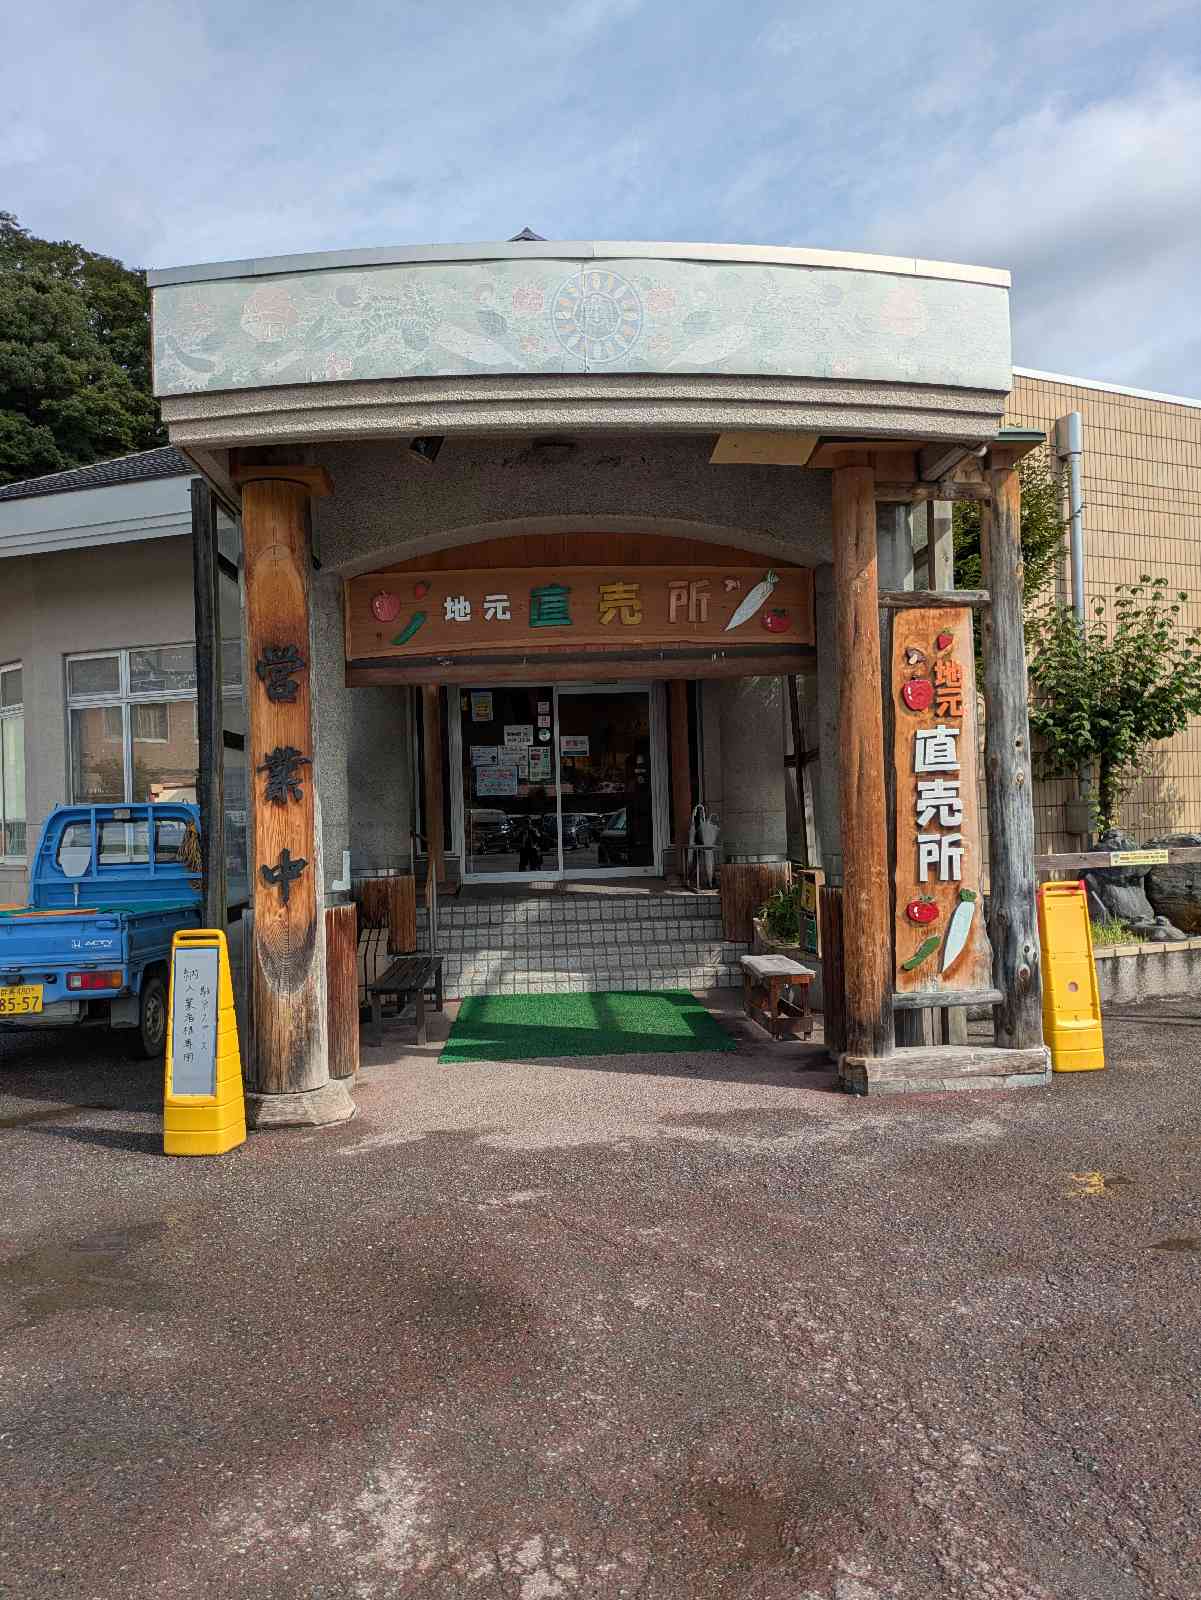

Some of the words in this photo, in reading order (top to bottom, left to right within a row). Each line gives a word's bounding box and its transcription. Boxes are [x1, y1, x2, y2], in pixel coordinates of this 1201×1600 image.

[443, 579, 710, 627] 地元直売所
[933, 659, 965, 717] 地元
[256, 643, 312, 903] 営業中
[914, 725, 965, 882] 直売所
